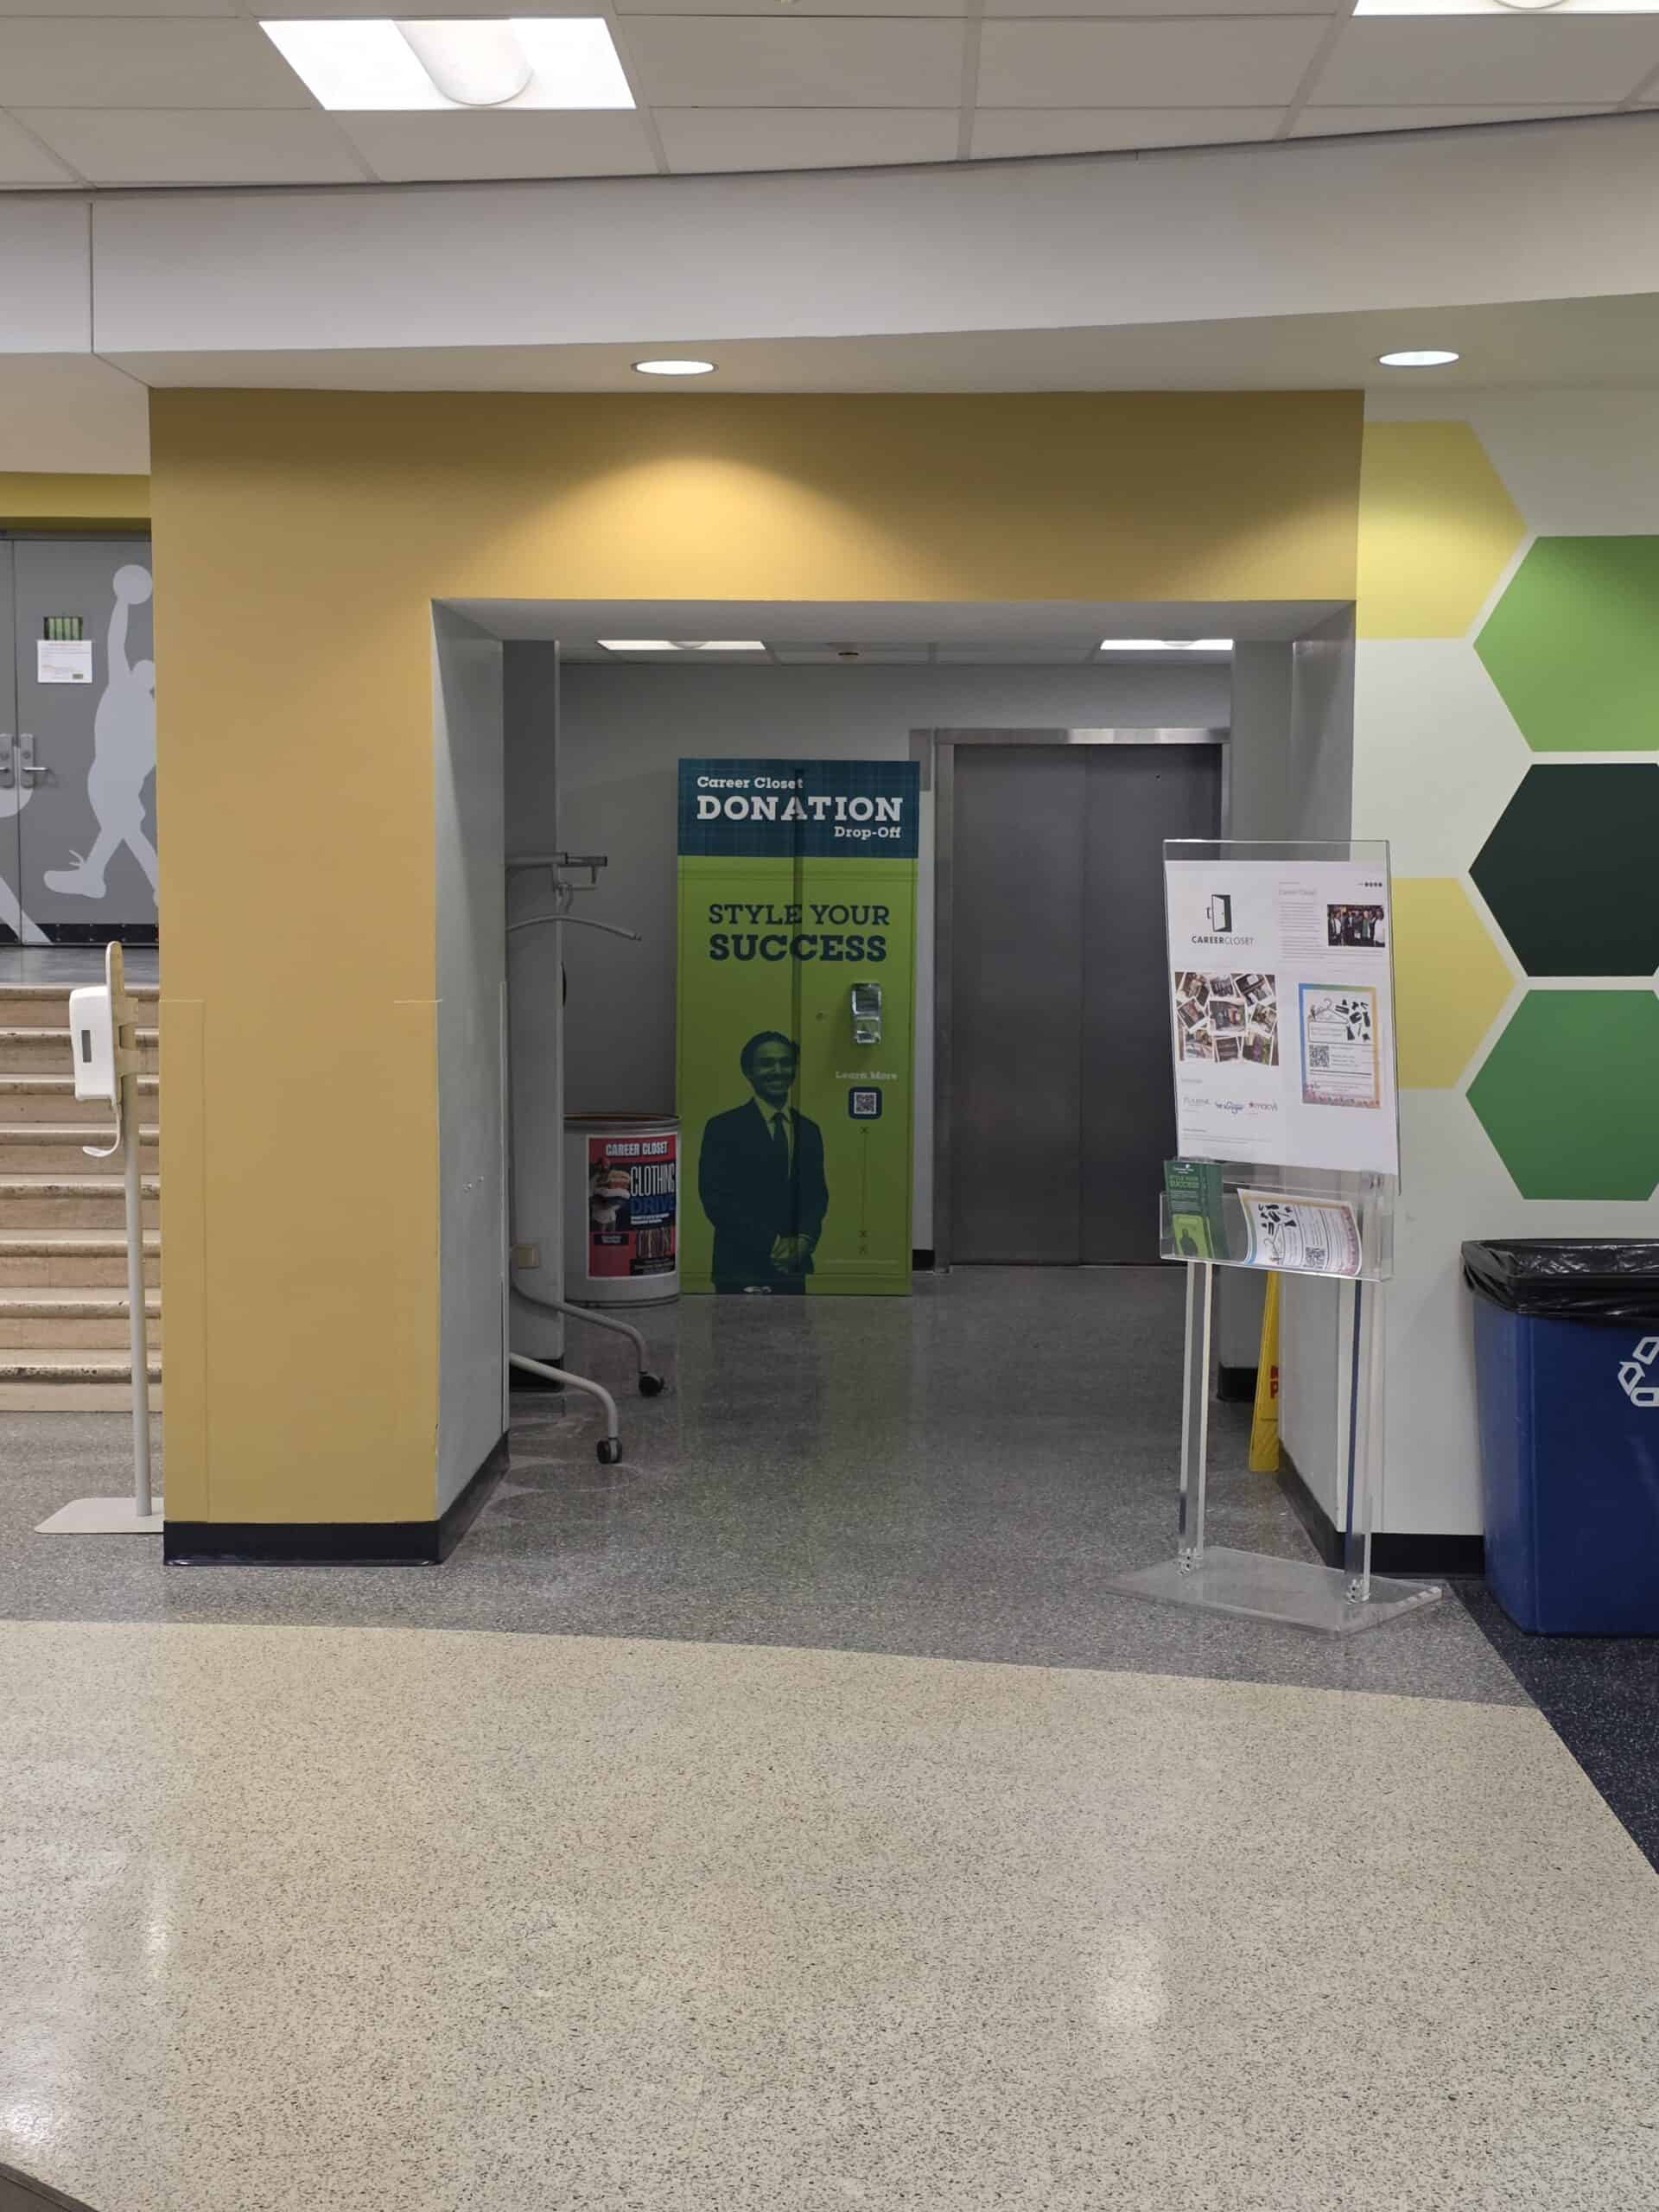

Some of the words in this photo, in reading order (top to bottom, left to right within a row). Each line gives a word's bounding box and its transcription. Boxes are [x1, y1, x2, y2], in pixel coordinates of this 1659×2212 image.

[696, 776, 750, 789] Career
[753, 777, 804, 789] Closet
[696, 795, 903, 821] DONATION
[834, 826, 901, 840] Drop-Off
[709, 904, 802, 925] STYLE
[810, 905, 890, 926] YOUR
[709, 934, 887, 962] SUCCESS
[835, 1071, 868, 1079] Learn
[870, 1071, 898, 1080] More
[606, 1143, 640, 1157] CAREER
[642, 1141, 669, 1155] CLOSET
[630, 1162, 676, 1198] CLOTHING
